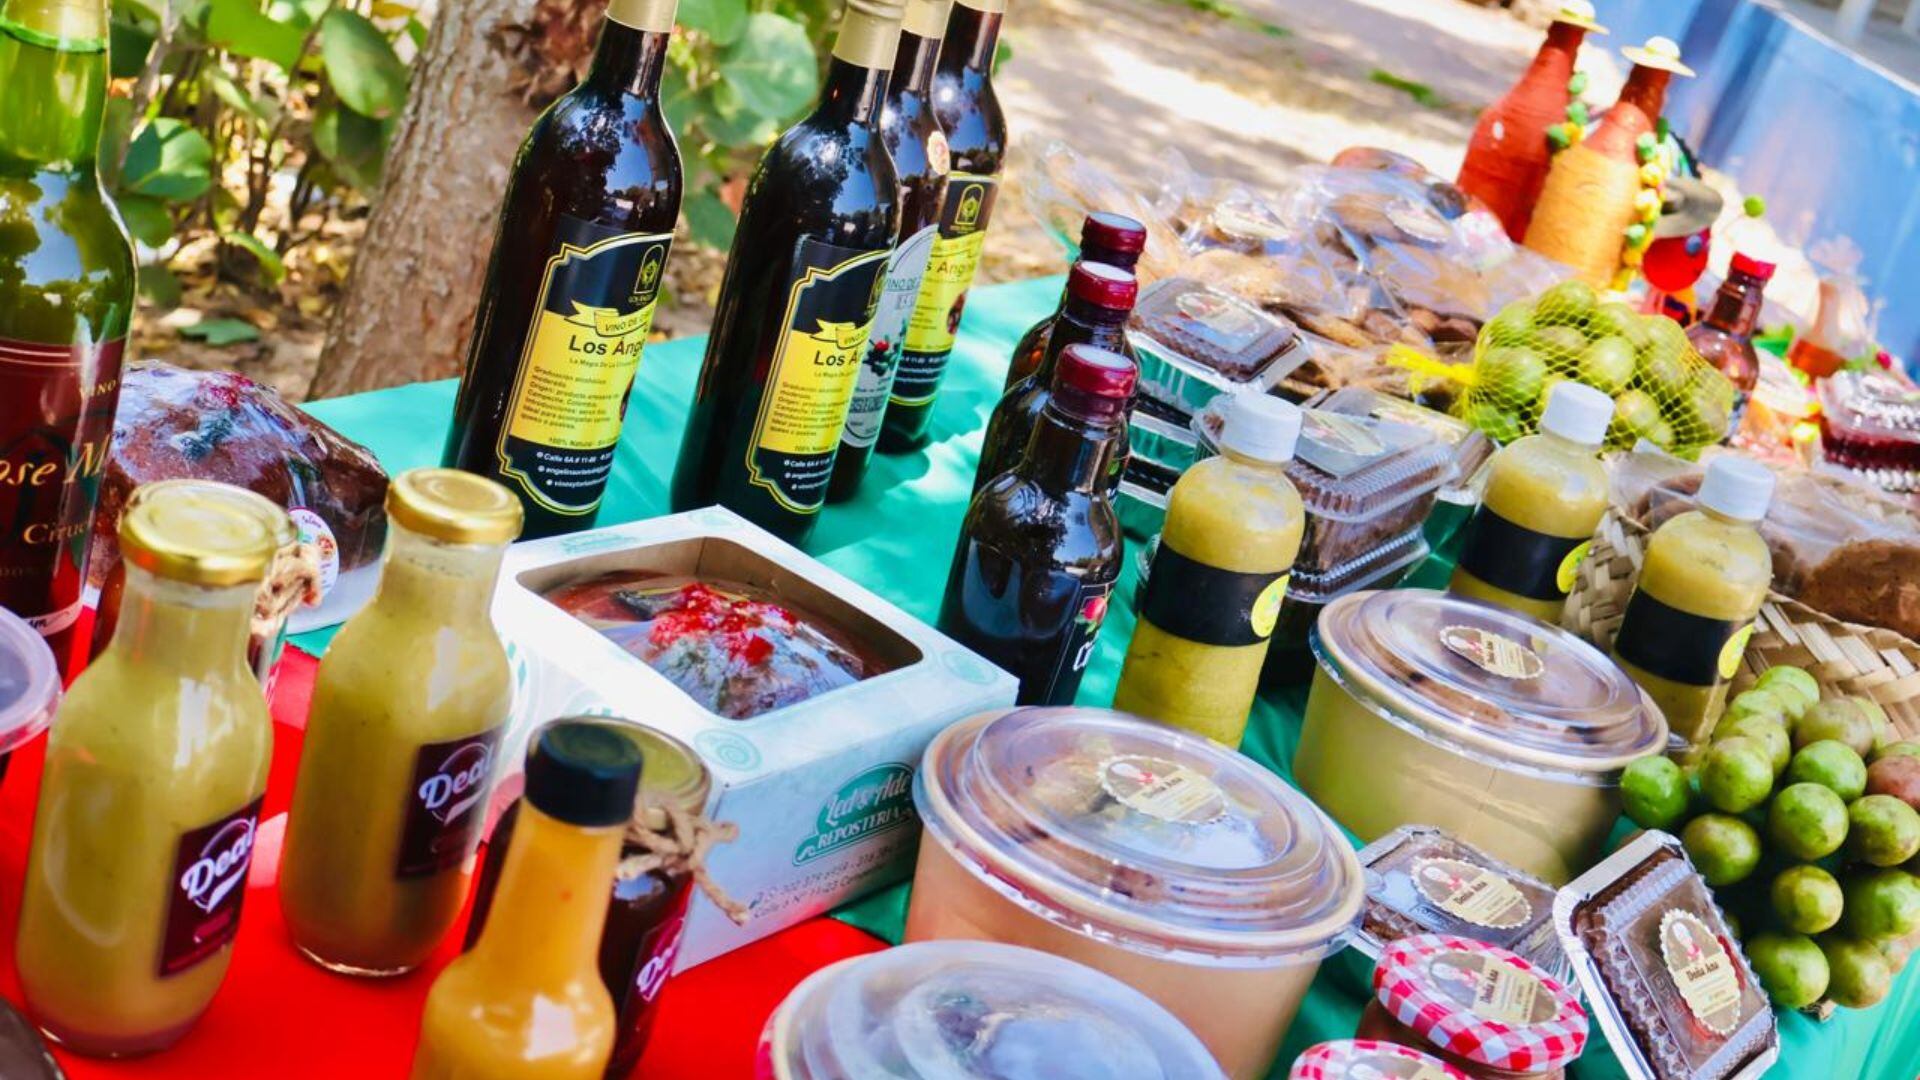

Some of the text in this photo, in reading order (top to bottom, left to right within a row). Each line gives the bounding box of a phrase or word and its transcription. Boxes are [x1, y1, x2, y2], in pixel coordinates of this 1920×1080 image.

[605, 320, 627, 332] VINO
[568, 334, 608, 356] Los
[814, 350, 846, 366] Los
[544, 453, 563, 462] Calle
